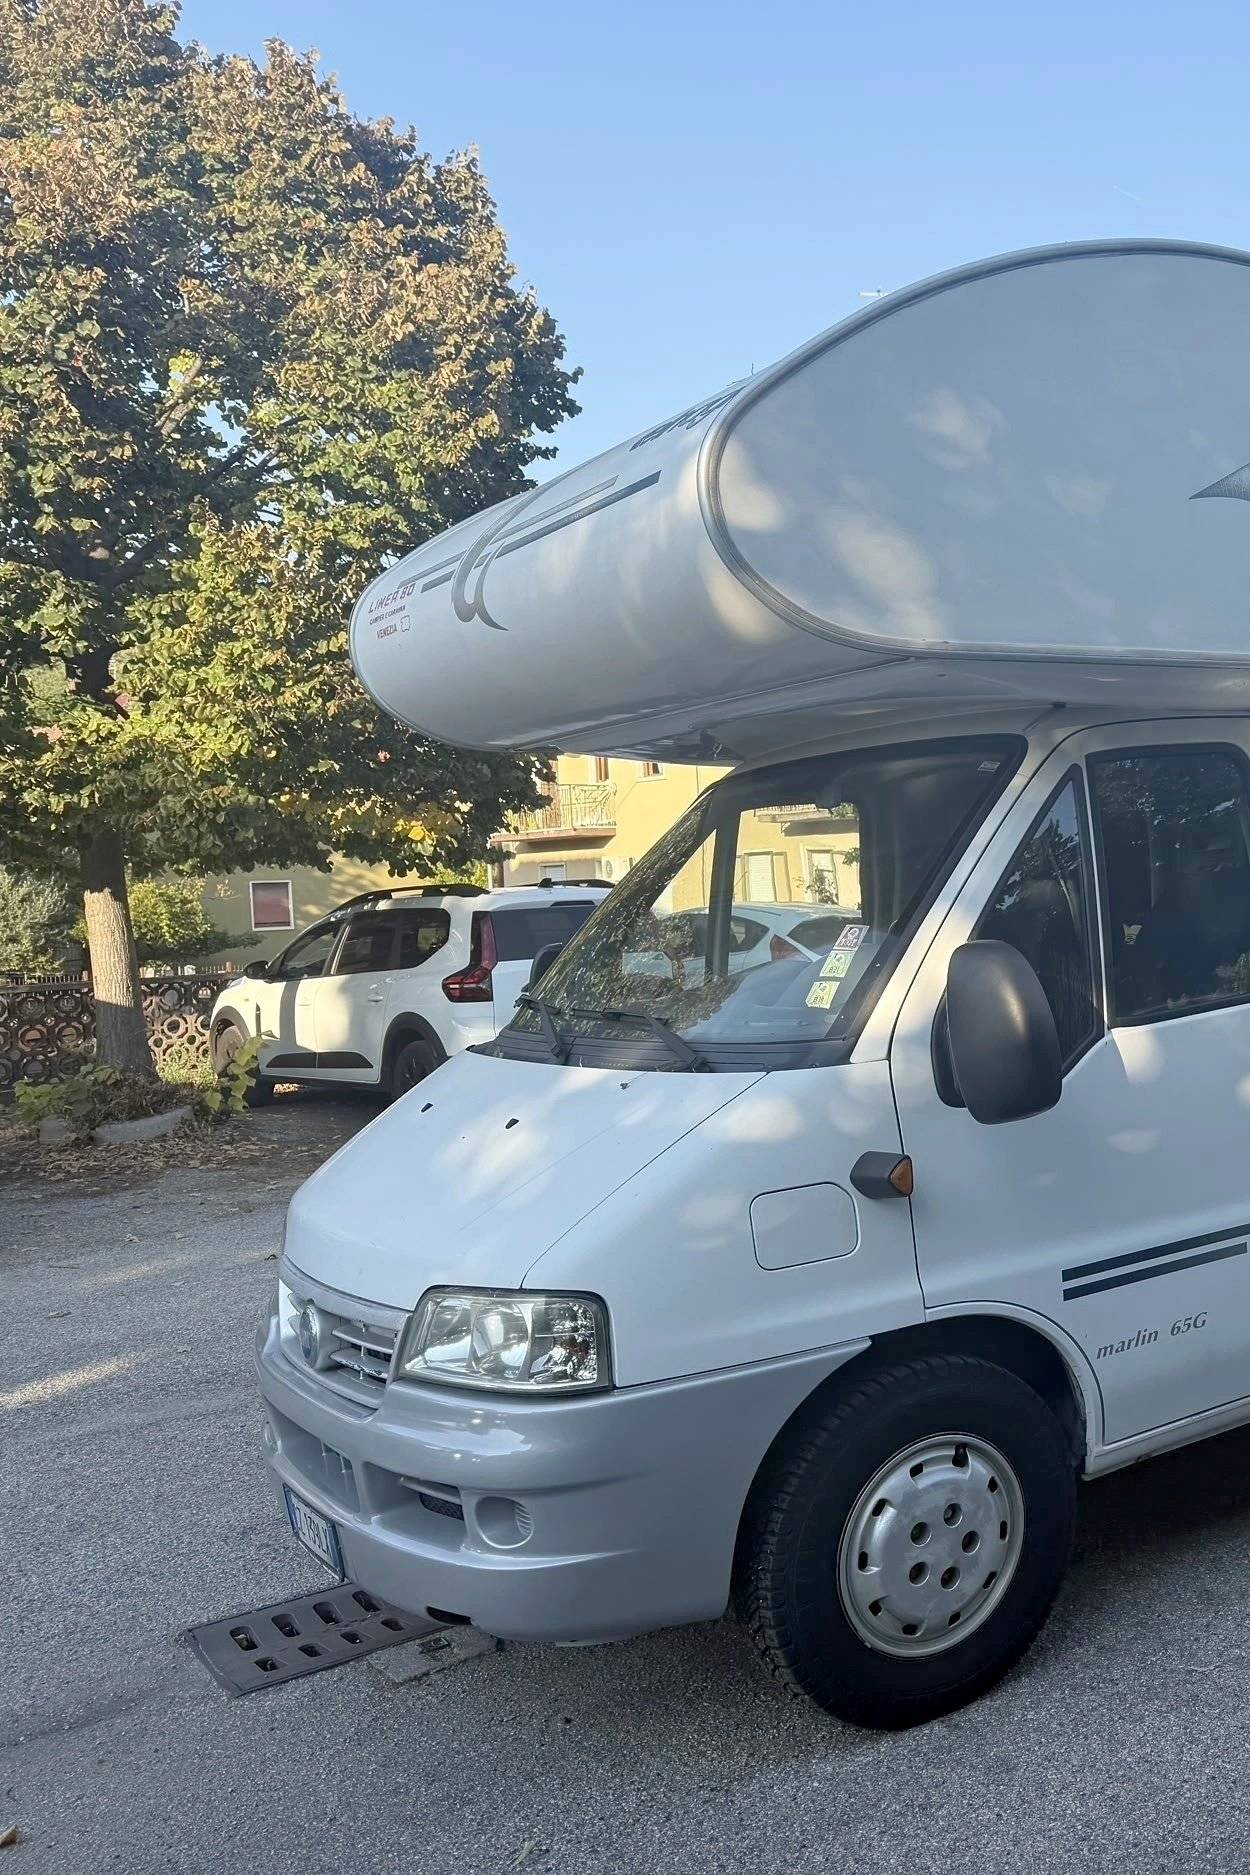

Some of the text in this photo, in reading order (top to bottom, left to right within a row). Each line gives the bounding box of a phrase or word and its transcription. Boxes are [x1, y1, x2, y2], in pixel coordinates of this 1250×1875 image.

[368, 590, 400, 613] LINEA
[376, 623, 398, 639] VENEZIA
[1096, 1311, 1208, 1360] marlin 65G
